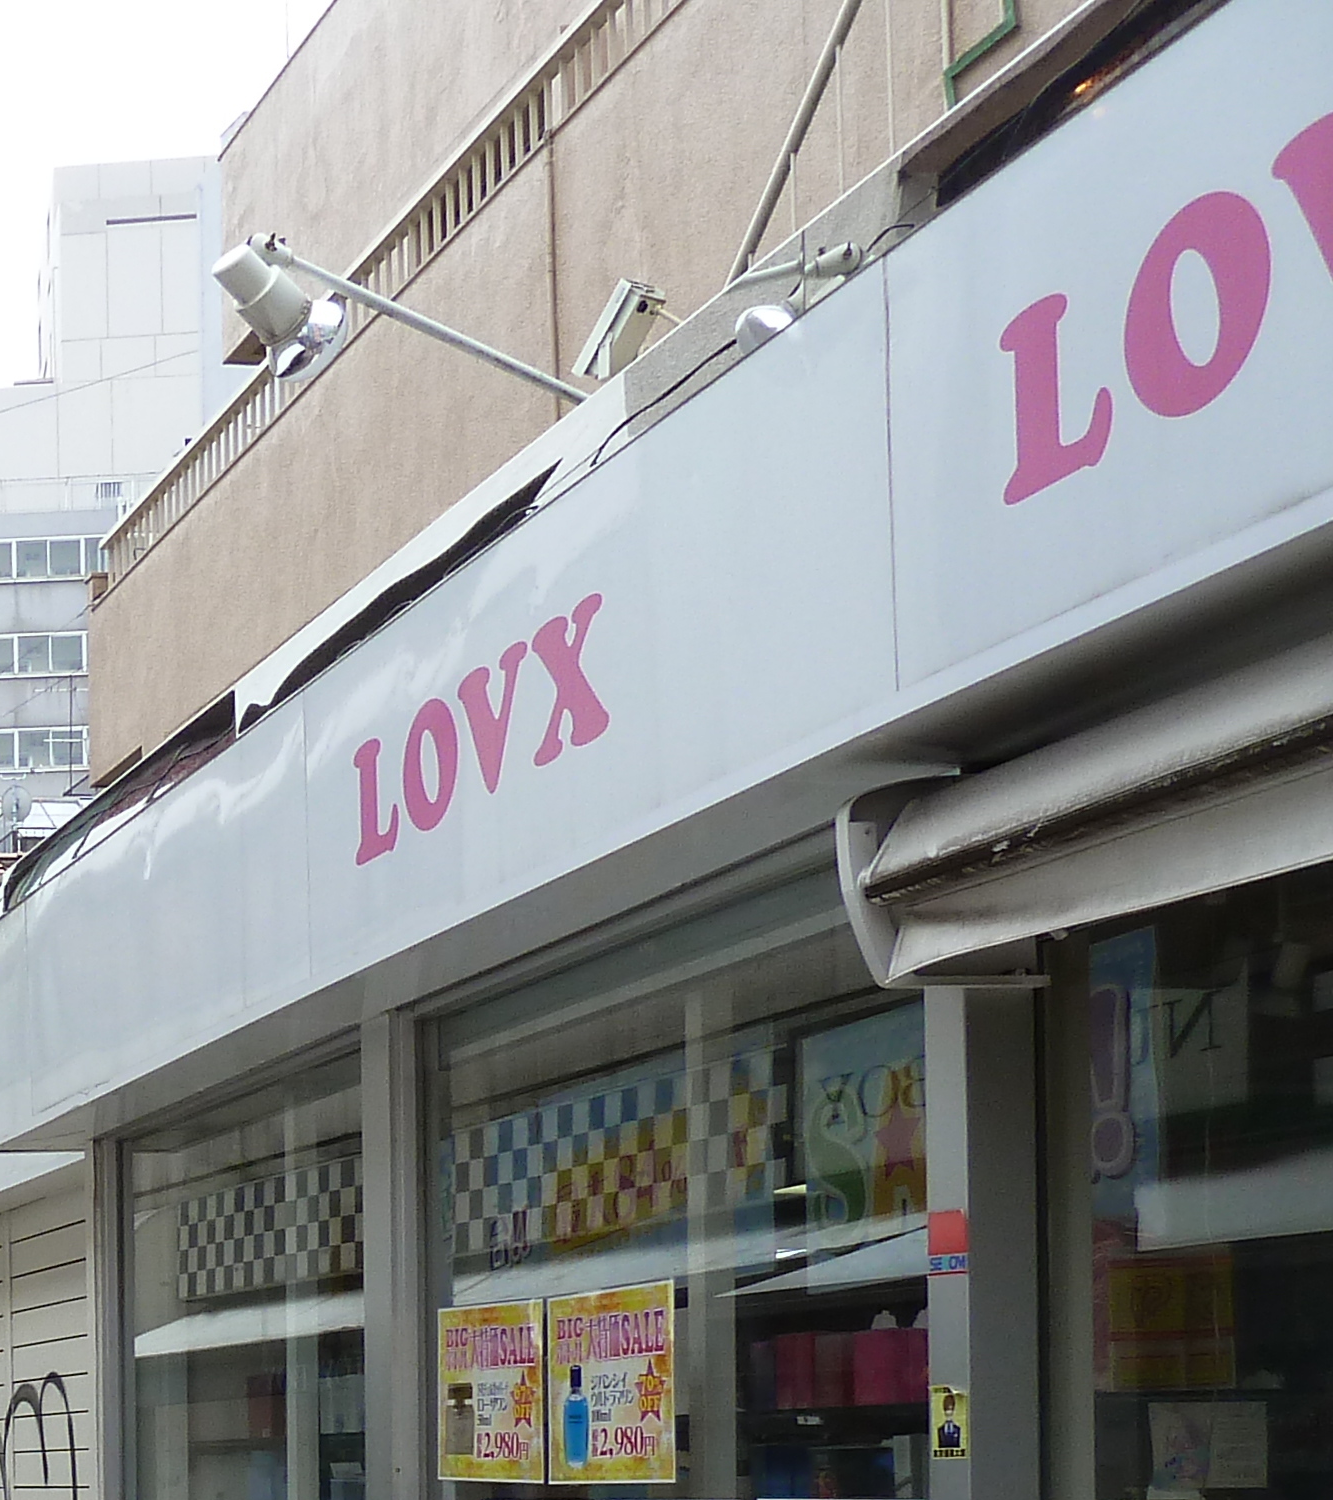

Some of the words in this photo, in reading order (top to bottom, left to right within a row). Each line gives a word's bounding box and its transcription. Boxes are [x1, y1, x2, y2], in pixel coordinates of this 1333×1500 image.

[353, 593, 610, 866] LOVX
[446, 1328, 469, 1348] BIG
[556, 1317, 583, 1341] BIG
[620, 1309, 666, 1356] SALE
[513, 1405, 531, 1420] OFF
[639, 1395, 661, 1412] OFF
[483, 1431, 529, 1460] 2,980円
[599, 1425, 656, 1460] 2,980円
